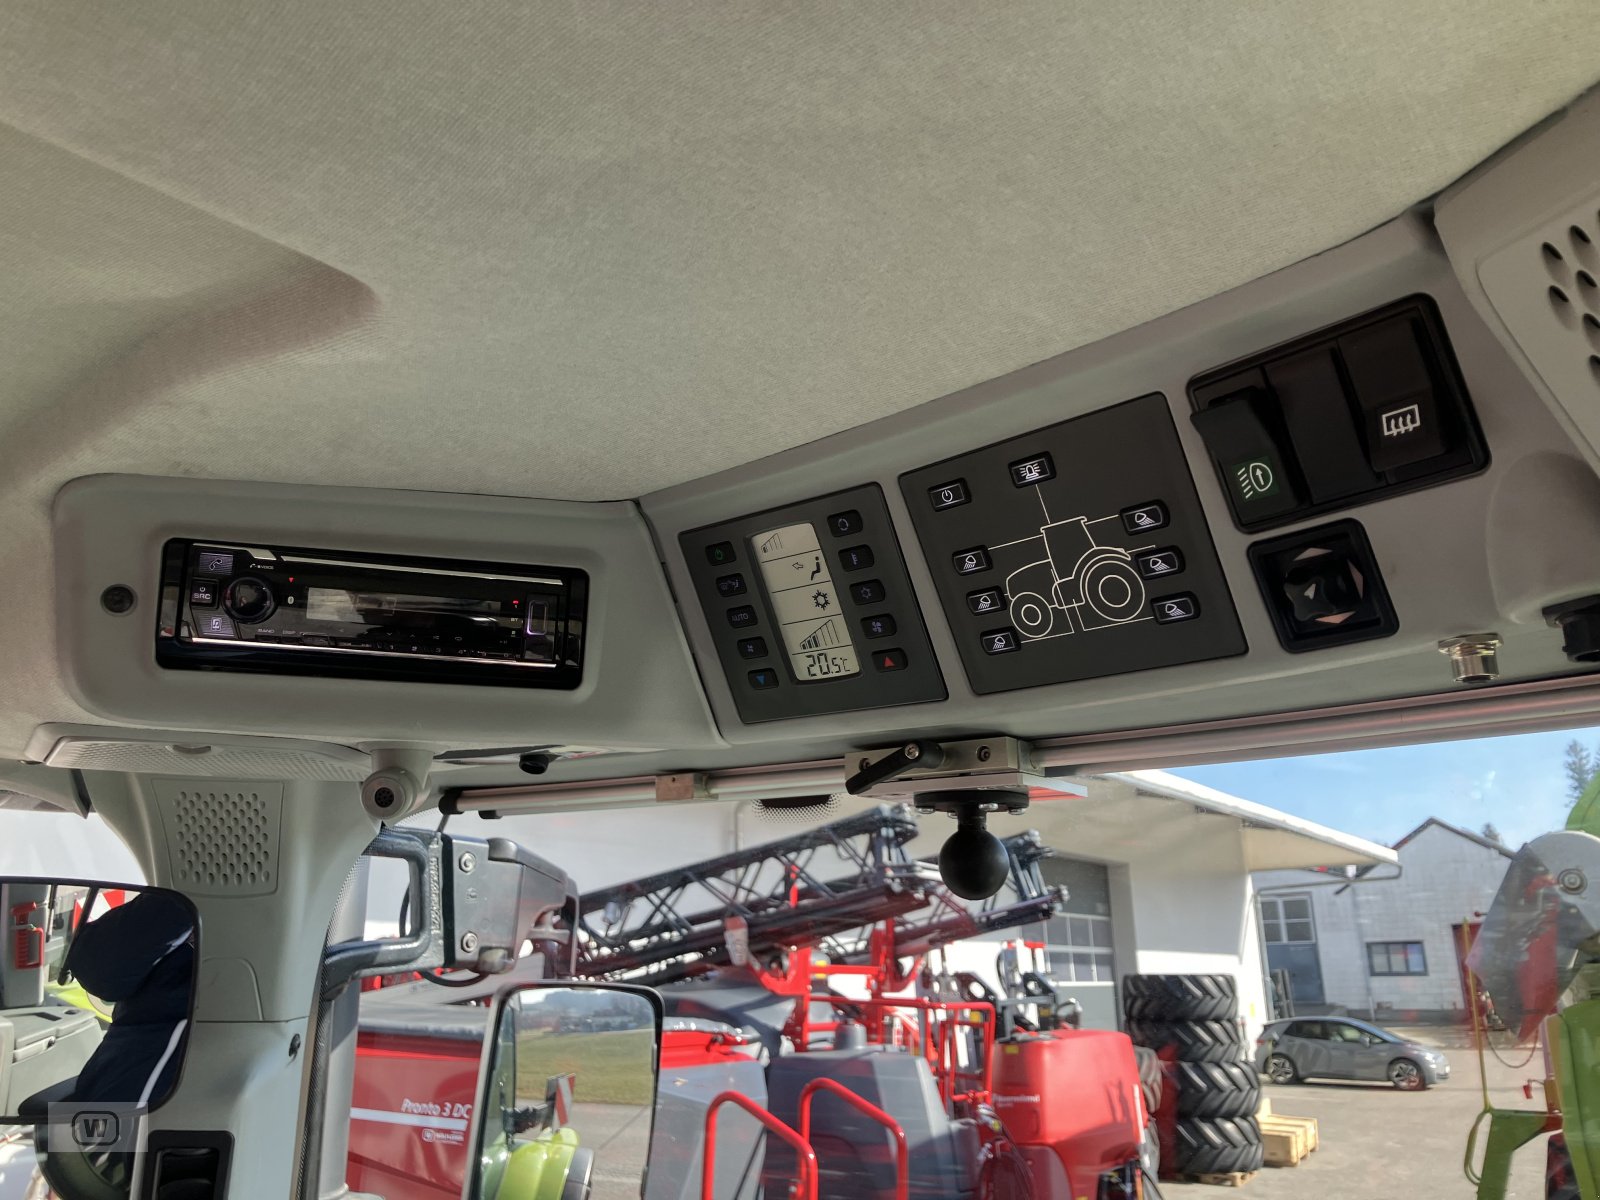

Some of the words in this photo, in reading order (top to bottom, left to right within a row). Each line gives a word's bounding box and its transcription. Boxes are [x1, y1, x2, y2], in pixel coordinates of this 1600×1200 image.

[193, 592, 212, 600] SRC
[731, 612, 749, 622] AUTO
[401, 1097, 441, 1116] Pronto
[442, 1101, 452, 1117] 3
[452, 1102, 473, 1119] DC
